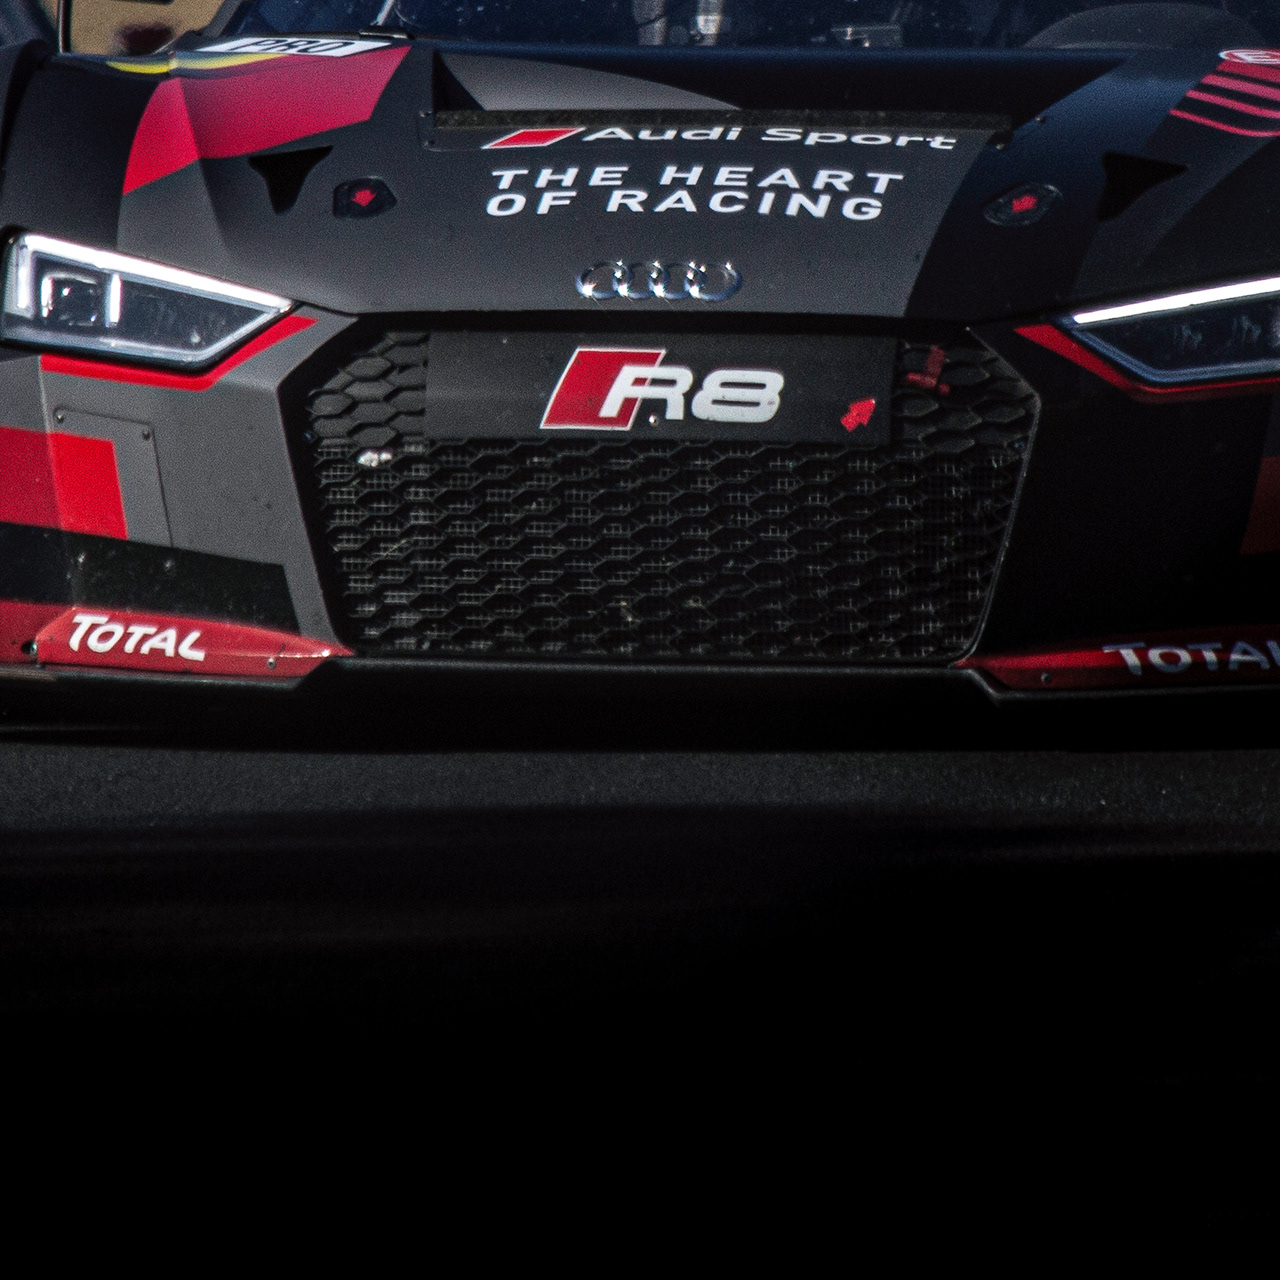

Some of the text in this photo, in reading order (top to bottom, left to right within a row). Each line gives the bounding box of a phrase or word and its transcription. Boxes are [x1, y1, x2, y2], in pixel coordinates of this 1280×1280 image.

[582, 127, 957, 150] Audi Sport
[491, 166, 904, 193] THE HEART
[486, 190, 884, 220] OF RACING
[598, 366, 785, 424] R8
